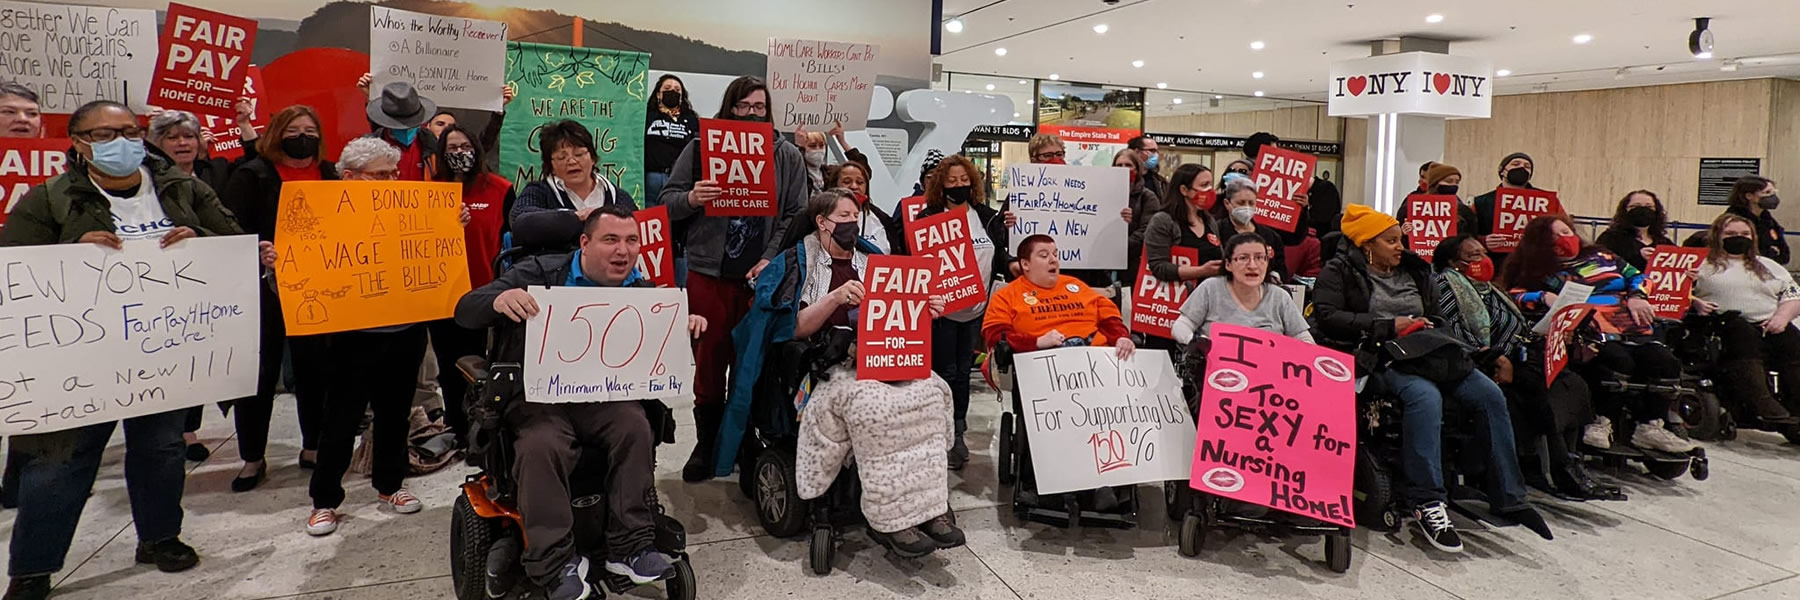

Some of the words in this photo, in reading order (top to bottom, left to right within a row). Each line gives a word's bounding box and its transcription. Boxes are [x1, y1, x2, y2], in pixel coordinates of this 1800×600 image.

[68, 7, 98, 34] We
[106, 9, 139, 37] Can
[173, 15, 246, 51] FAIR
[372, 6, 405, 30] Who's
[410, 19, 423, 32] the
[428, 17, 459, 41] Worthy
[0, 31, 32, 53] ove
[44, 32, 133, 60] Mountains,
[401, 39, 410, 54] A
[415, 40, 460, 58] Billionaire
[48, 55, 73, 78] We
[80, 56, 117, 80] Cant
[166, 44, 240, 81] PAY
[400, 65, 416, 84] My
[467, 71, 489, 82] Home
[63, 79, 83, 109] At
[186, 79, 212, 92] FOR
[417, 80, 436, 92] Care
[441, 83, 467, 93] Worker
[1335, 77, 1345, 97] I
[1368, 71, 1412, 95] NY
[1422, 71, 1432, 93] I
[1451, 74, 1486, 97] NY
[160, 88, 196, 103] HOME
[197, 95, 231, 109] CARE
[530, 98, 553, 117] WE
[559, 98, 586, 118] ARE
[591, 100, 615, 118] THE
[229, 127, 242, 136] FO
[707, 129, 765, 155] FAIR
[1002, 127, 1020, 135] BLDG
[1059, 129, 1070, 137] The
[1071, 130, 1091, 139] Empire
[1092, 131, 1107, 139] State
[1107, 132, 1120, 140] Trail
[1176, 137, 1205, 145] ARCHIVES,
[214, 139, 242, 152] HOME
[0, 150, 67, 176] AIR
[708, 157, 766, 184] PAY
[1260, 152, 1308, 179] FAIR
[729, 187, 750, 196] FOR
[1064, 179, 1086, 189] NEEDS
[1256, 173, 1302, 201] PAY
[336, 189, 356, 214] A
[371, 189, 419, 212] BONUS
[428, 189, 455, 209] PAYS
[712, 199, 740, 208] HOME
[742, 199, 770, 208] CARE
[1264, 199, 1280, 209] FOR
[1412, 201, 1452, 217] FAIR
[1501, 194, 1549, 213] FAIR
[370, 215, 386, 233] A
[400, 214, 434, 231] BILL
[1013, 217, 1039, 236] NOT
[1048, 220, 1058, 235] A
[1065, 220, 1088, 236] NEW
[1269, 209, 1292, 223] CARE
[1500, 212, 1537, 231] PA
[300, 230, 327, 241] 150%
[639, 218, 664, 247] IR
[914, 218, 964, 251] FAIR
[1411, 219, 1451, 238] PAY
[281, 245, 298, 273] A
[319, 242, 384, 270] WAGE
[401, 239, 431, 260] HIKE
[435, 237, 463, 257] PAYS
[636, 247, 665, 280] AY
[921, 243, 966, 277] AY
[1652, 252, 1699, 269] FAIR
[0, 261, 66, 305] EW
[83, 251, 207, 306] YORK
[352, 270, 389, 294] THE
[403, 262, 447, 288] BILLS
[870, 266, 932, 294] FAIR
[942, 276, 960, 289] FOR
[1139, 274, 1187, 303] PAY
[1650, 271, 1688, 291] PAY
[957, 284, 979, 300] CARE
[866, 299, 926, 331] PAY
[1030, 301, 1085, 314] FREEDOM
[1134, 313, 1157, 325] HOME
[1151, 303, 1168, 314] FOR
[1661, 304, 1680, 312] CARE
[0, 308, 106, 351] EEDS
[141, 323, 215, 353] Care!
[538, 302, 681, 376] 150%
[885, 337, 905, 349] FOR
[866, 354, 895, 368] HOME
[897, 354, 924, 367] CARE
[1033, 351, 1104, 392] Thank
[1104, 351, 1148, 389] You
[1218, 332, 1313, 387] I'm
[0, 372, 35, 401] ot
[63, 376, 94, 392] a
[528, 378, 543, 396] of
[548, 374, 603, 396] Minimum
[605, 375, 635, 398] Wage
[649, 379, 666, 392] Fair
[669, 376, 682, 393] Pay
[4, 387, 165, 430] Stadium
[1032, 398, 1063, 432] For
[1070, 392, 1162, 431] Supporting
[1157, 393, 1184, 424] Us
[1214, 398, 1304, 447] SEXY
[1313, 423, 1350, 456] for
[1255, 435, 1274, 453] a
[1200, 439, 1306, 493] Nursing
